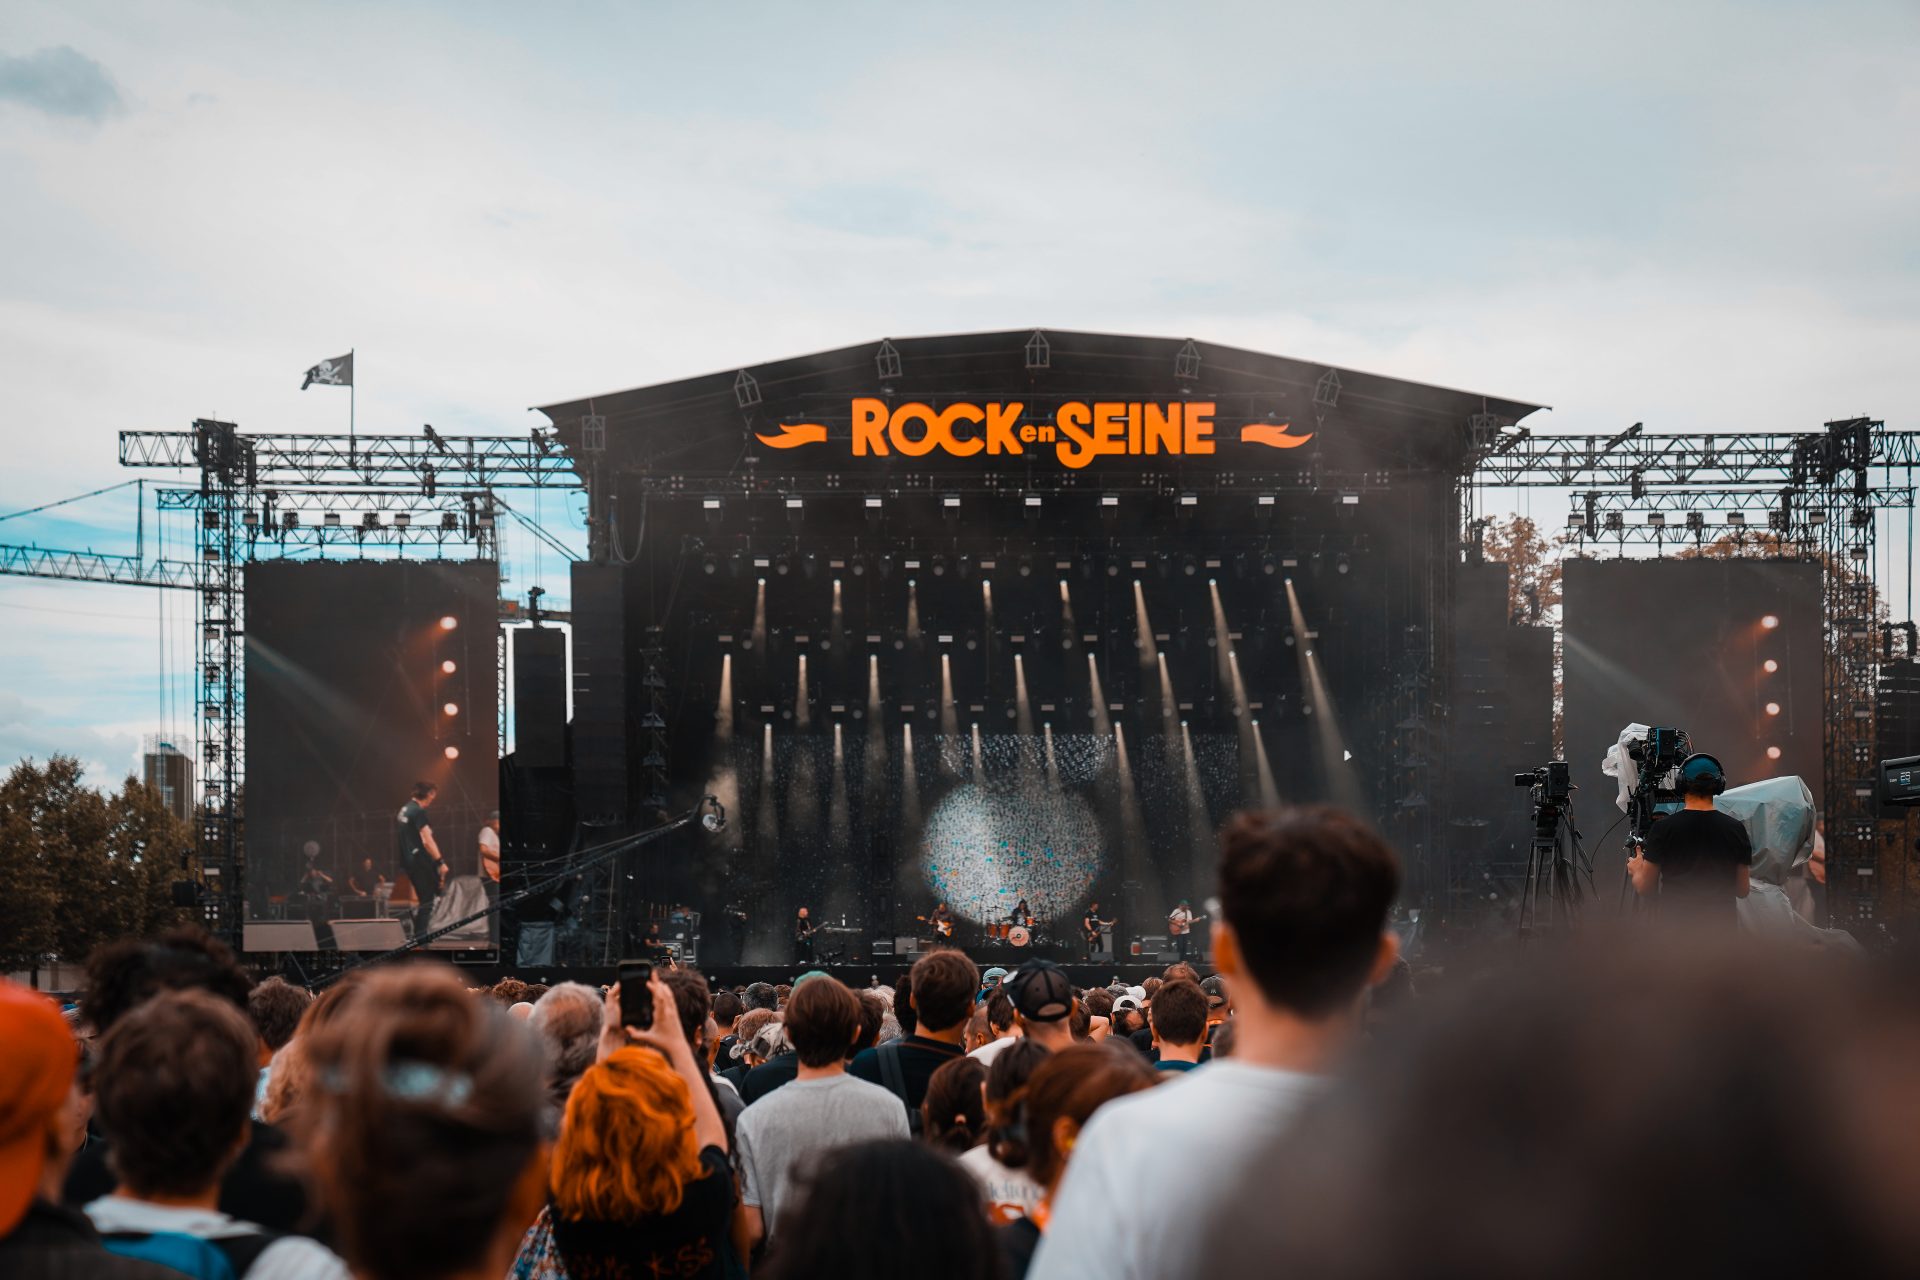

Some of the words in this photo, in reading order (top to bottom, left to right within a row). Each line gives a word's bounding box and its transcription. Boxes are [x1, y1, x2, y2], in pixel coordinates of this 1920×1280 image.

[851, 398, 1023, 457] ROCK
[1019, 424, 1056, 443] en
[1055, 402, 1216, 469] SEINE
